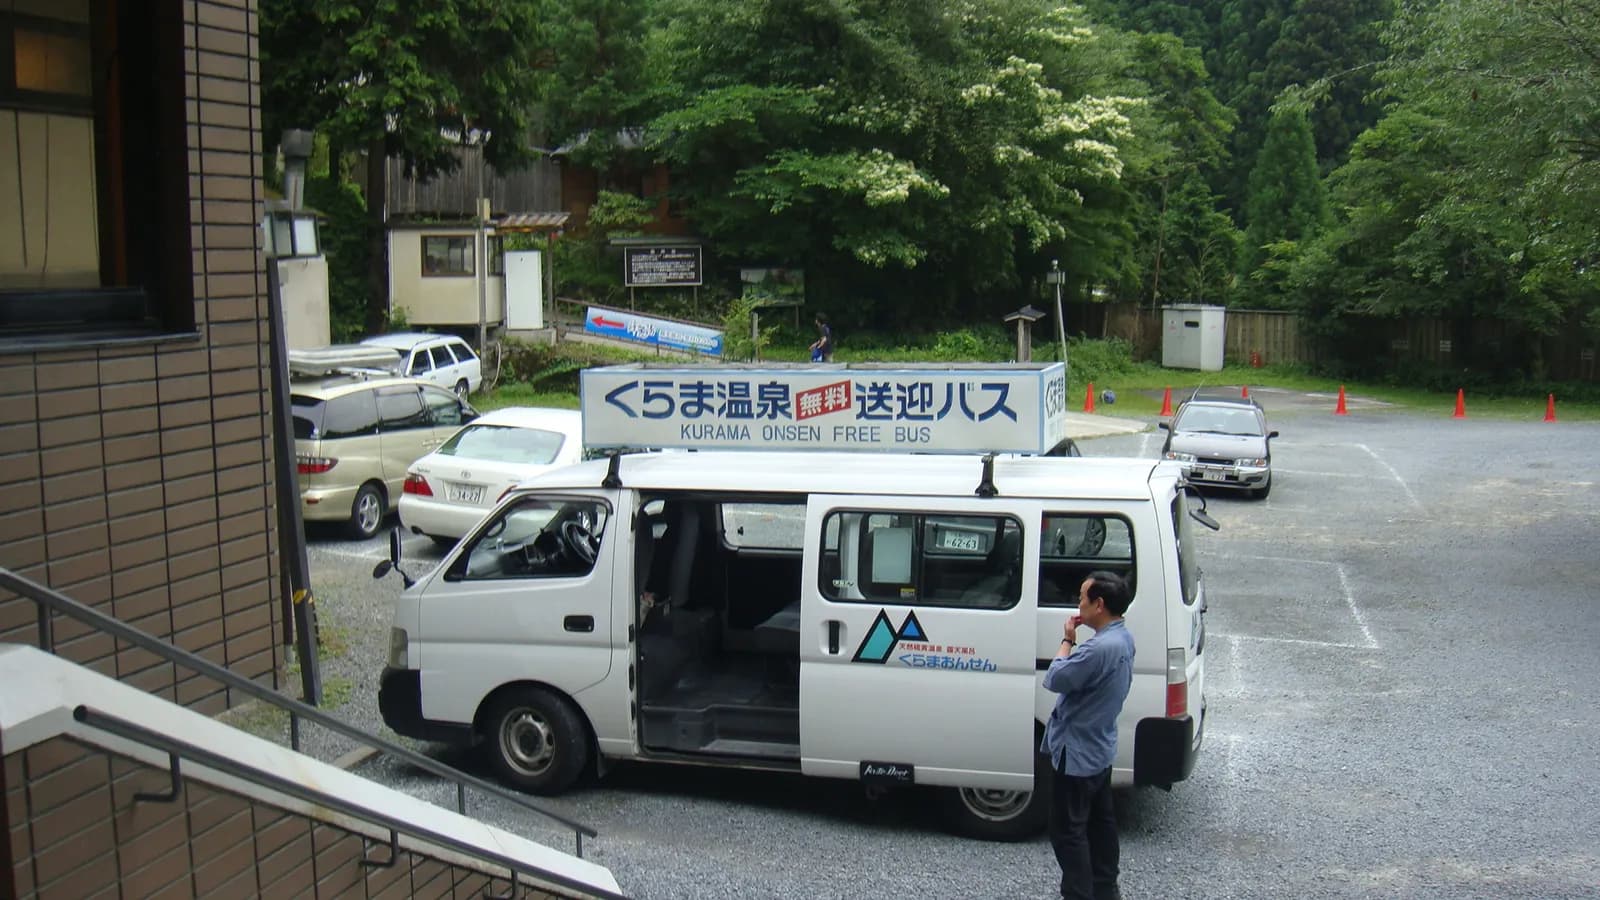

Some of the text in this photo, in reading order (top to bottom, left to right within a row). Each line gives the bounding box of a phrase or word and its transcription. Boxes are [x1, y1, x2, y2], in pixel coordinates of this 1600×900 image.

[605, 380, 1018, 423] くらま温泉 無料 送迎バス
[681, 424, 931, 443] KURAMA ONSEN FREE BUS
[898, 654, 998, 672] くらまおんせん
